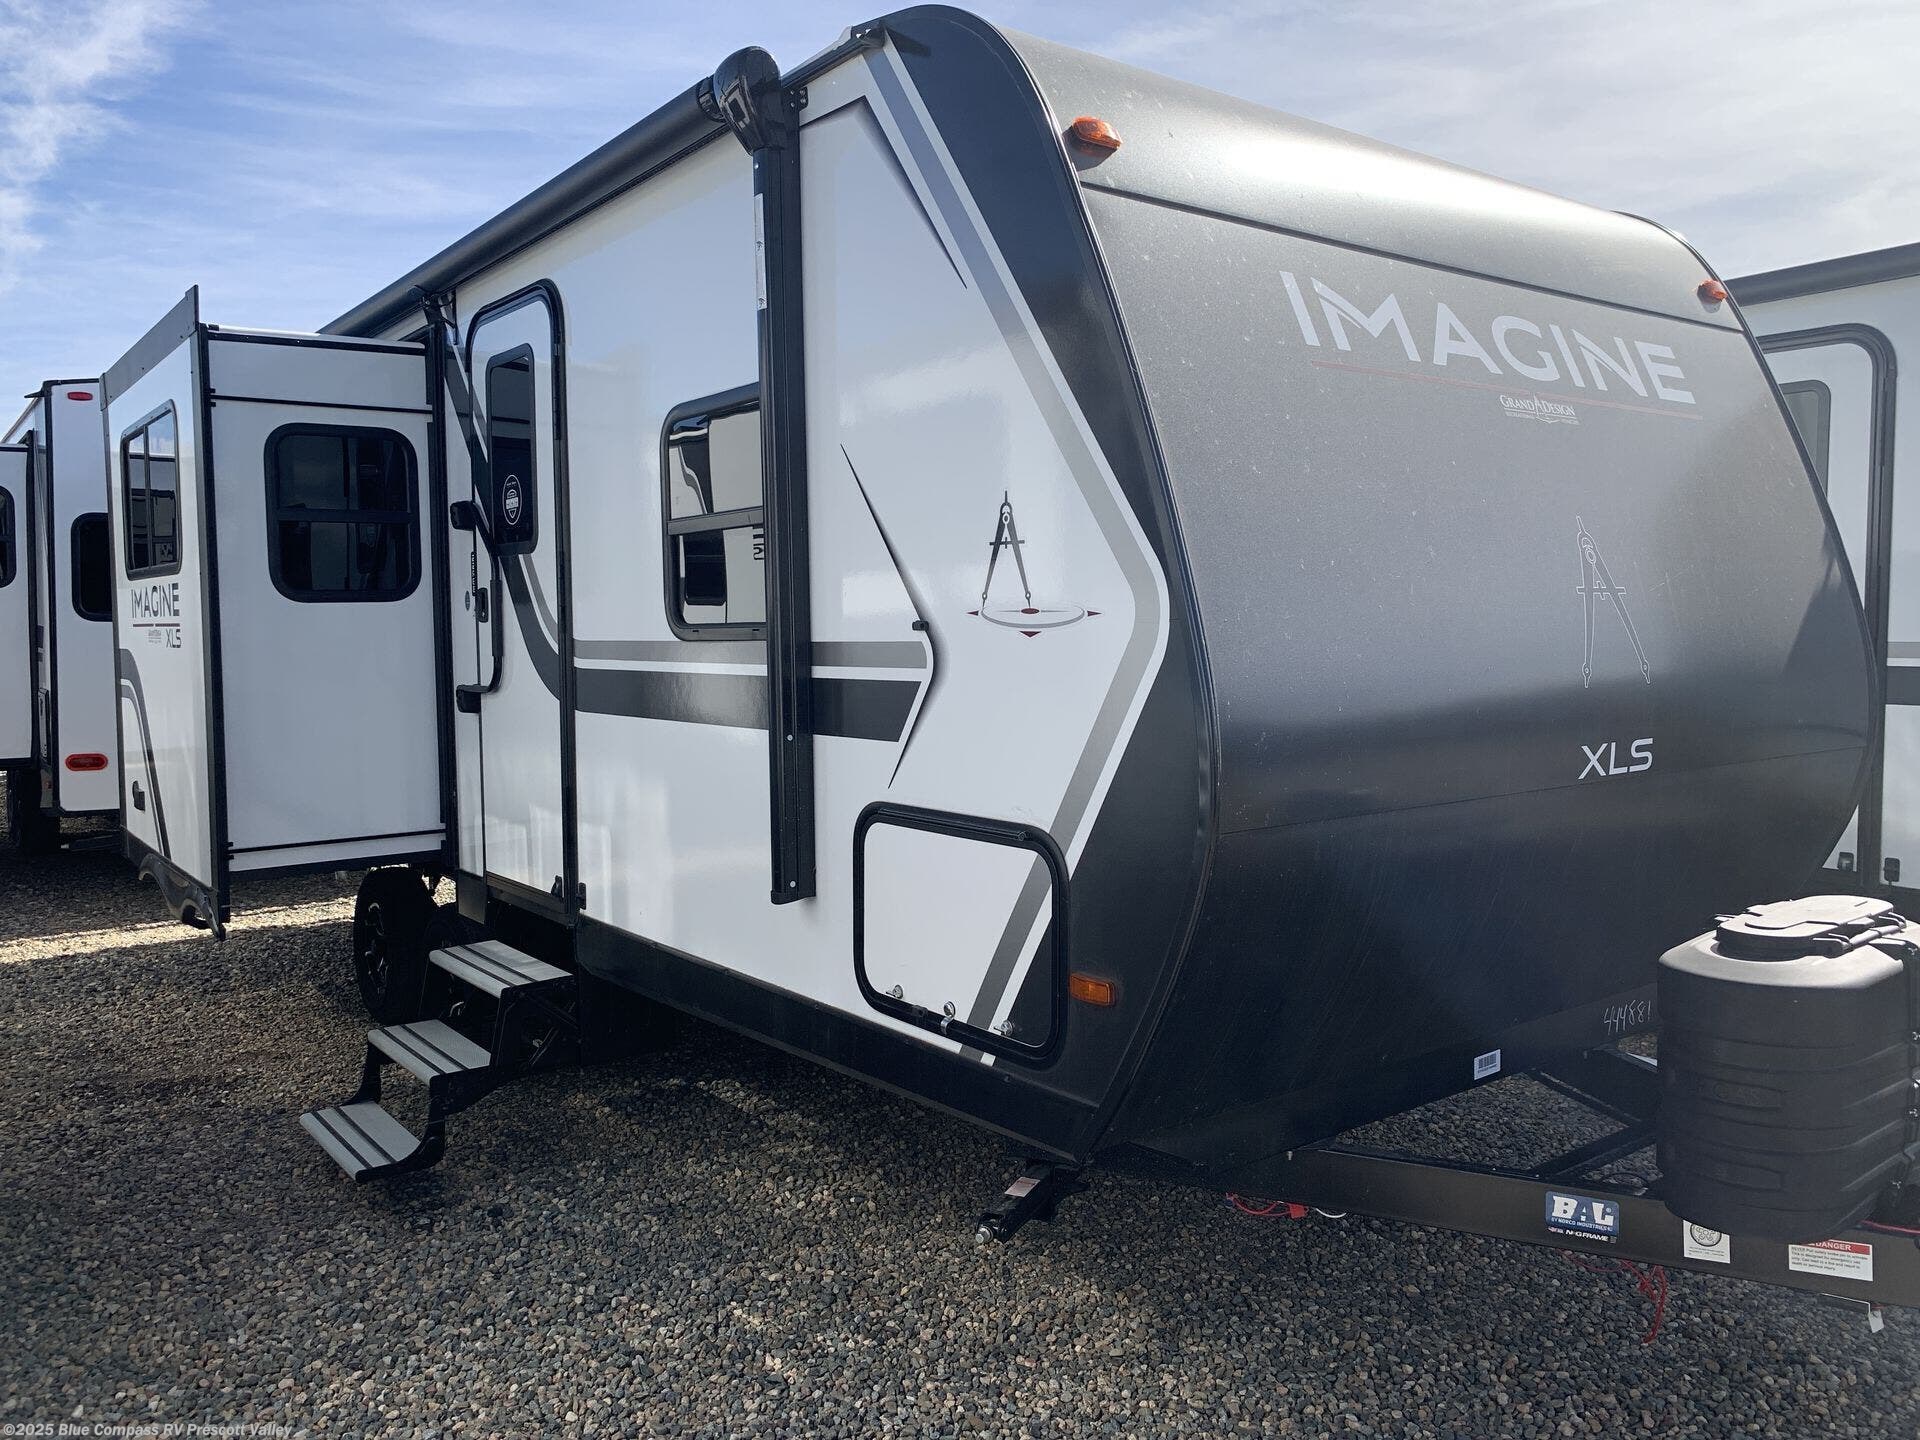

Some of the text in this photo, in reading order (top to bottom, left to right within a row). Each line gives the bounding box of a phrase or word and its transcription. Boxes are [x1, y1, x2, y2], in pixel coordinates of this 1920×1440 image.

[1279, 271, 1696, 404] IMAGINE
[1500, 394, 1535, 411] GRAND
[131, 582, 180, 618] IMAGINE
[166, 628, 181, 648] XLS
[1578, 738, 1653, 779] XLS
[1552, 1196, 1614, 1226] BAL
[1582, 1232, 1609, 1242] FRAME
[1816, 1242, 1851, 1251] DANGER
